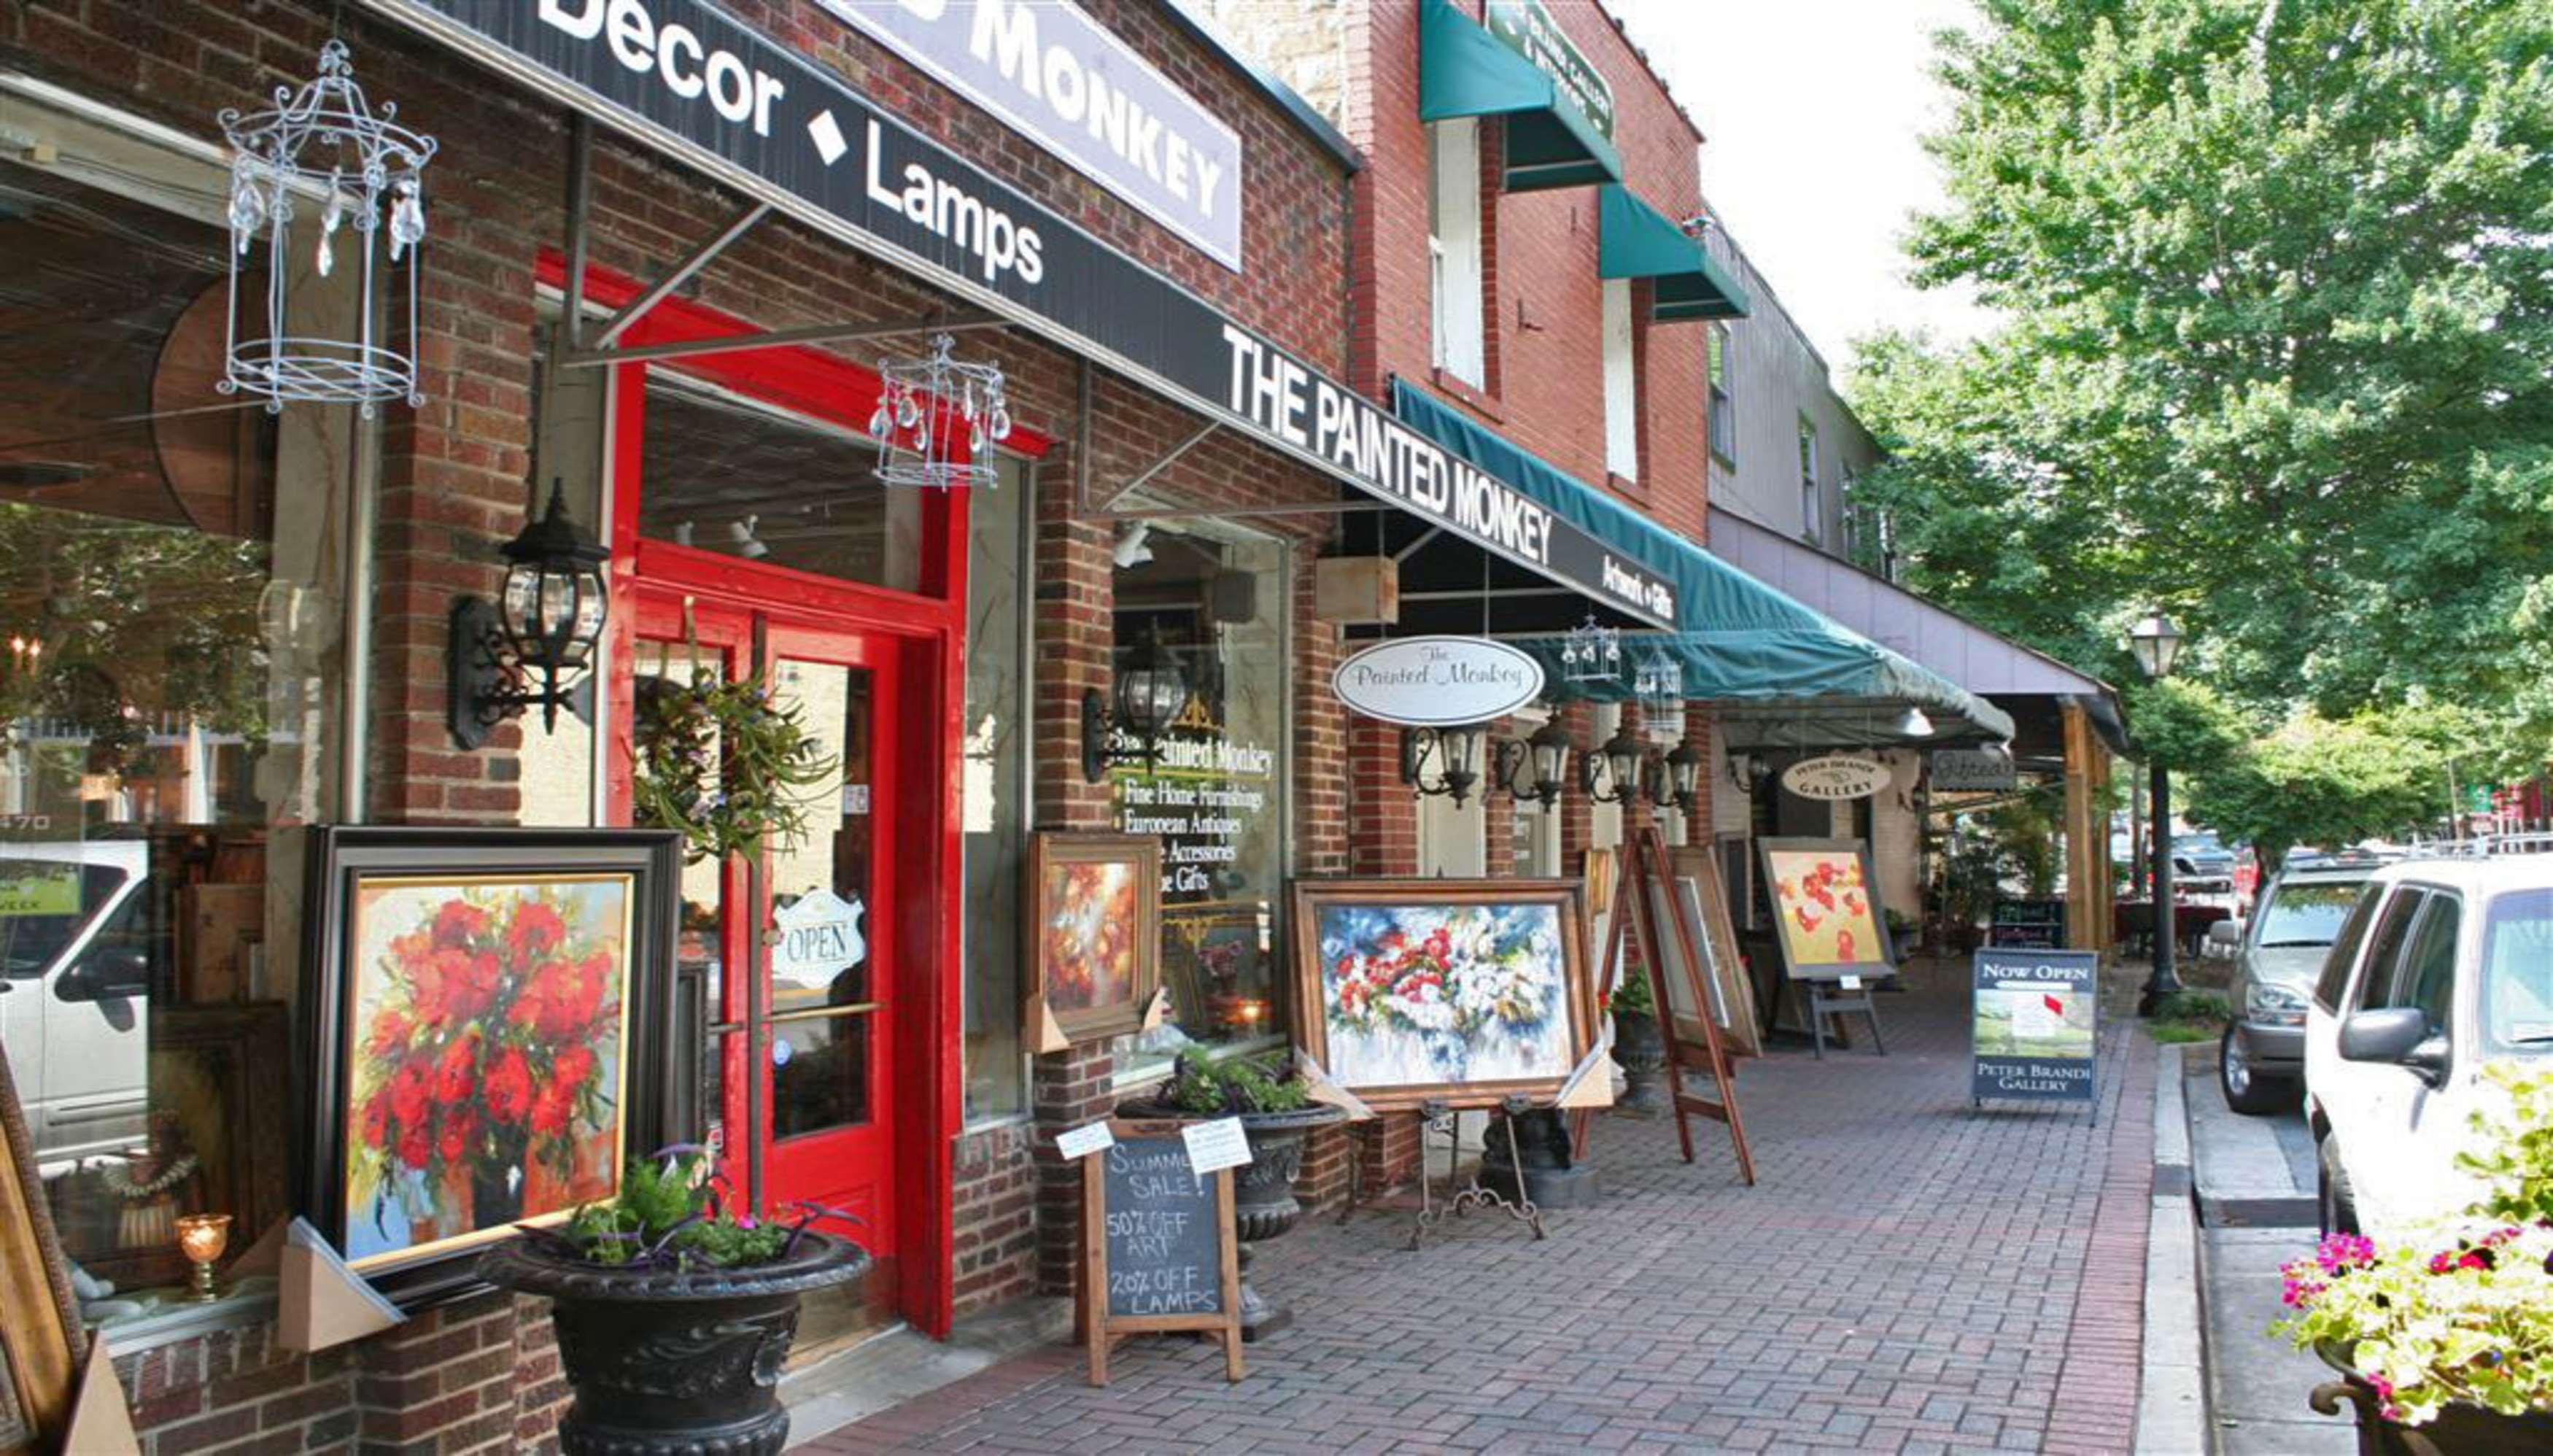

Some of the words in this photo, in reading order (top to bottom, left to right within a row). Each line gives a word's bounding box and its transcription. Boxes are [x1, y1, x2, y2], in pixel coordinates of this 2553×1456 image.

[969, 0, 1222, 218] MONKEY
[867, 118, 1043, 284] Lamps
[1223, 325, 1309, 448] THE
[1316, 379, 1449, 513] PAINTED
[1454, 462, 1553, 568] MONKEY
[1350, 664, 1430, 686] Painted
[1434, 662, 1522, 687] Monkey
[1153, 732, 1212, 767] ainted
[1216, 739, 1274, 781] Monkey
[1124, 778, 1155, 804] Fine
[1158, 780, 1197, 805] Home
[1799, 781, 1872, 796] GALLERY
[1124, 808, 1188, 834] European
[1169, 838, 1237, 864] Accessories
[787, 924, 848, 963] OPEN
[1983, 963, 2032, 979] NOW
[2034, 964, 2089, 980] OPEN
[1977, 1062, 2026, 1077] PETER
[2031, 1064, 2091, 1080] BRANDI
[1999, 1077, 2069, 1091] GALLERY
[1110, 1142, 1193, 1175] SUMME
[1106, 1210, 1147, 1237] 50%
[1148, 1210, 1189, 1237] OFF
[1126, 1236, 1169, 1259] ART
[1110, 1269, 1150, 1296] 20%
[1153, 1265, 1198, 1292] OFF
[1131, 1288, 1218, 1314] LAMPS
